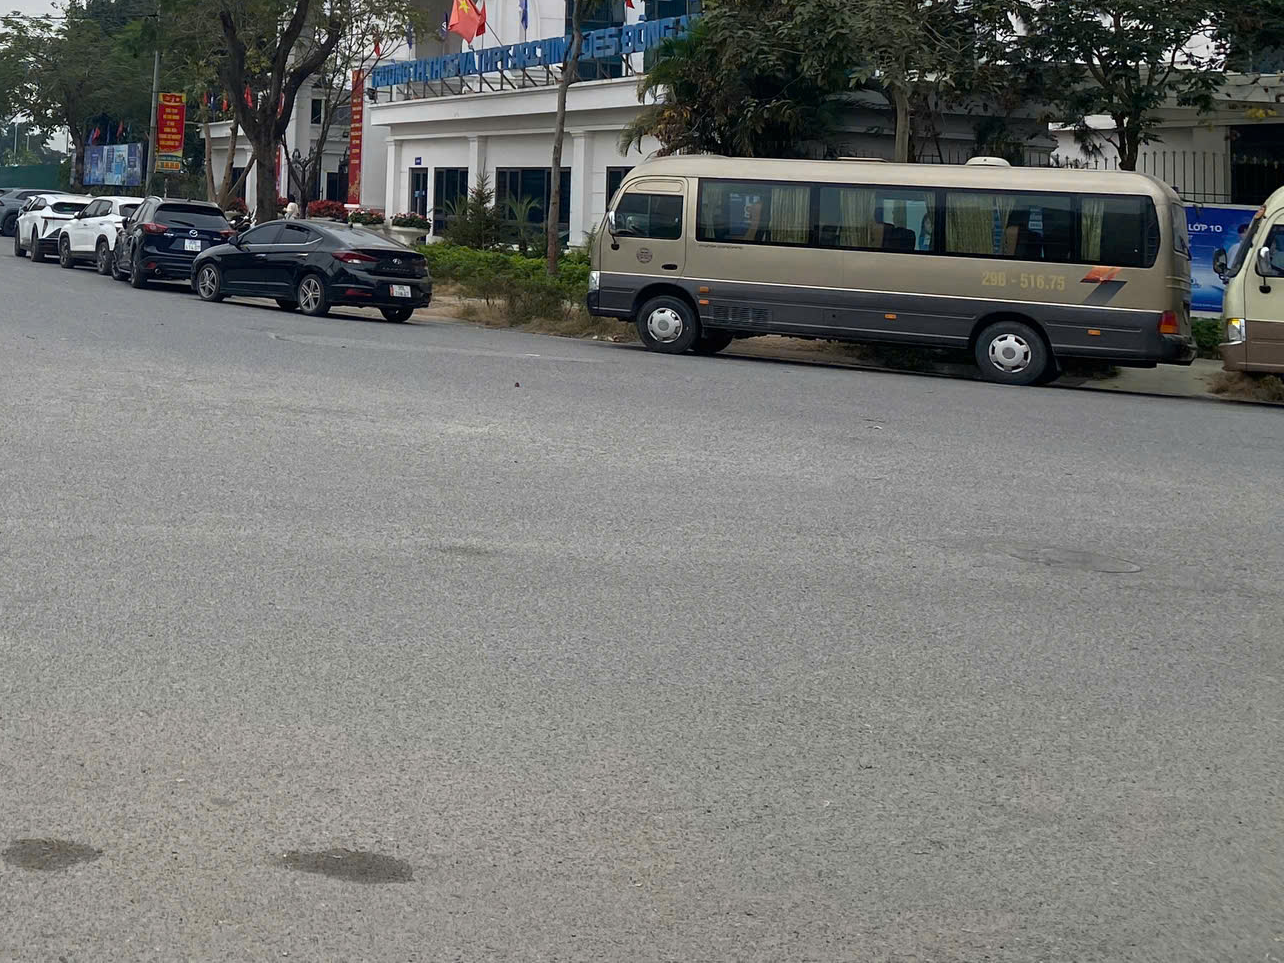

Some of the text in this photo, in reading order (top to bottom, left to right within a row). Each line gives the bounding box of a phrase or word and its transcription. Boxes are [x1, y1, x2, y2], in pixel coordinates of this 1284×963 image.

[477, 44, 511, 74] THPT
[511, 26, 616, 69] ARCHIMDES
[1209, 224, 1223, 233] 10
[1020, 272, 1066, 292] 516.75
